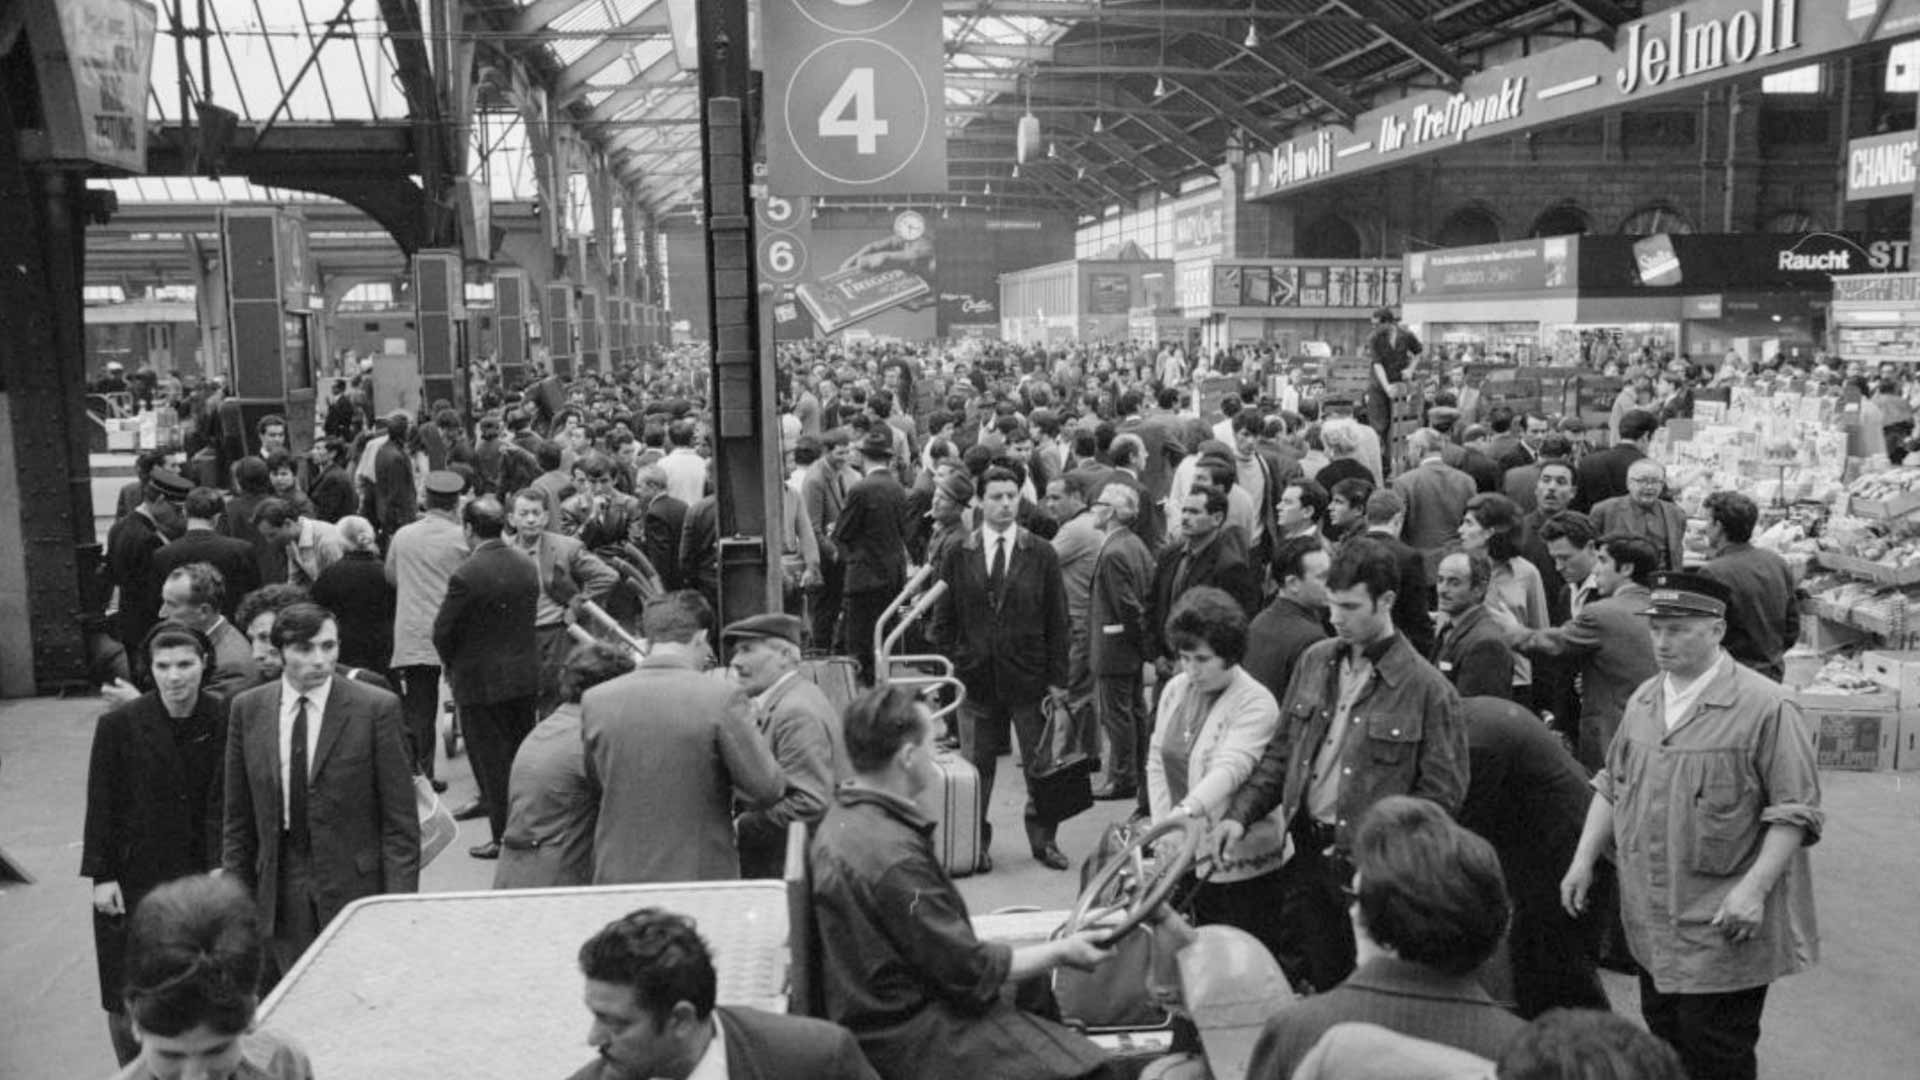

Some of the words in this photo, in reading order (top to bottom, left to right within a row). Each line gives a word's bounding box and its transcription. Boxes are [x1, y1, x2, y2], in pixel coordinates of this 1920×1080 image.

[1268, 131, 1332, 188] Jelmoli
[1378, 115, 1407, 153] Ihr
[1412, 77, 1524, 141] Treffpunkt
[1616, 0, 1797, 94] Jelmoli
[818, 67, 889, 154] 4
[768, 197, 793, 221] 5
[769, 241, 795, 272] 6
[1778, 250, 1850, 270] Raucht
